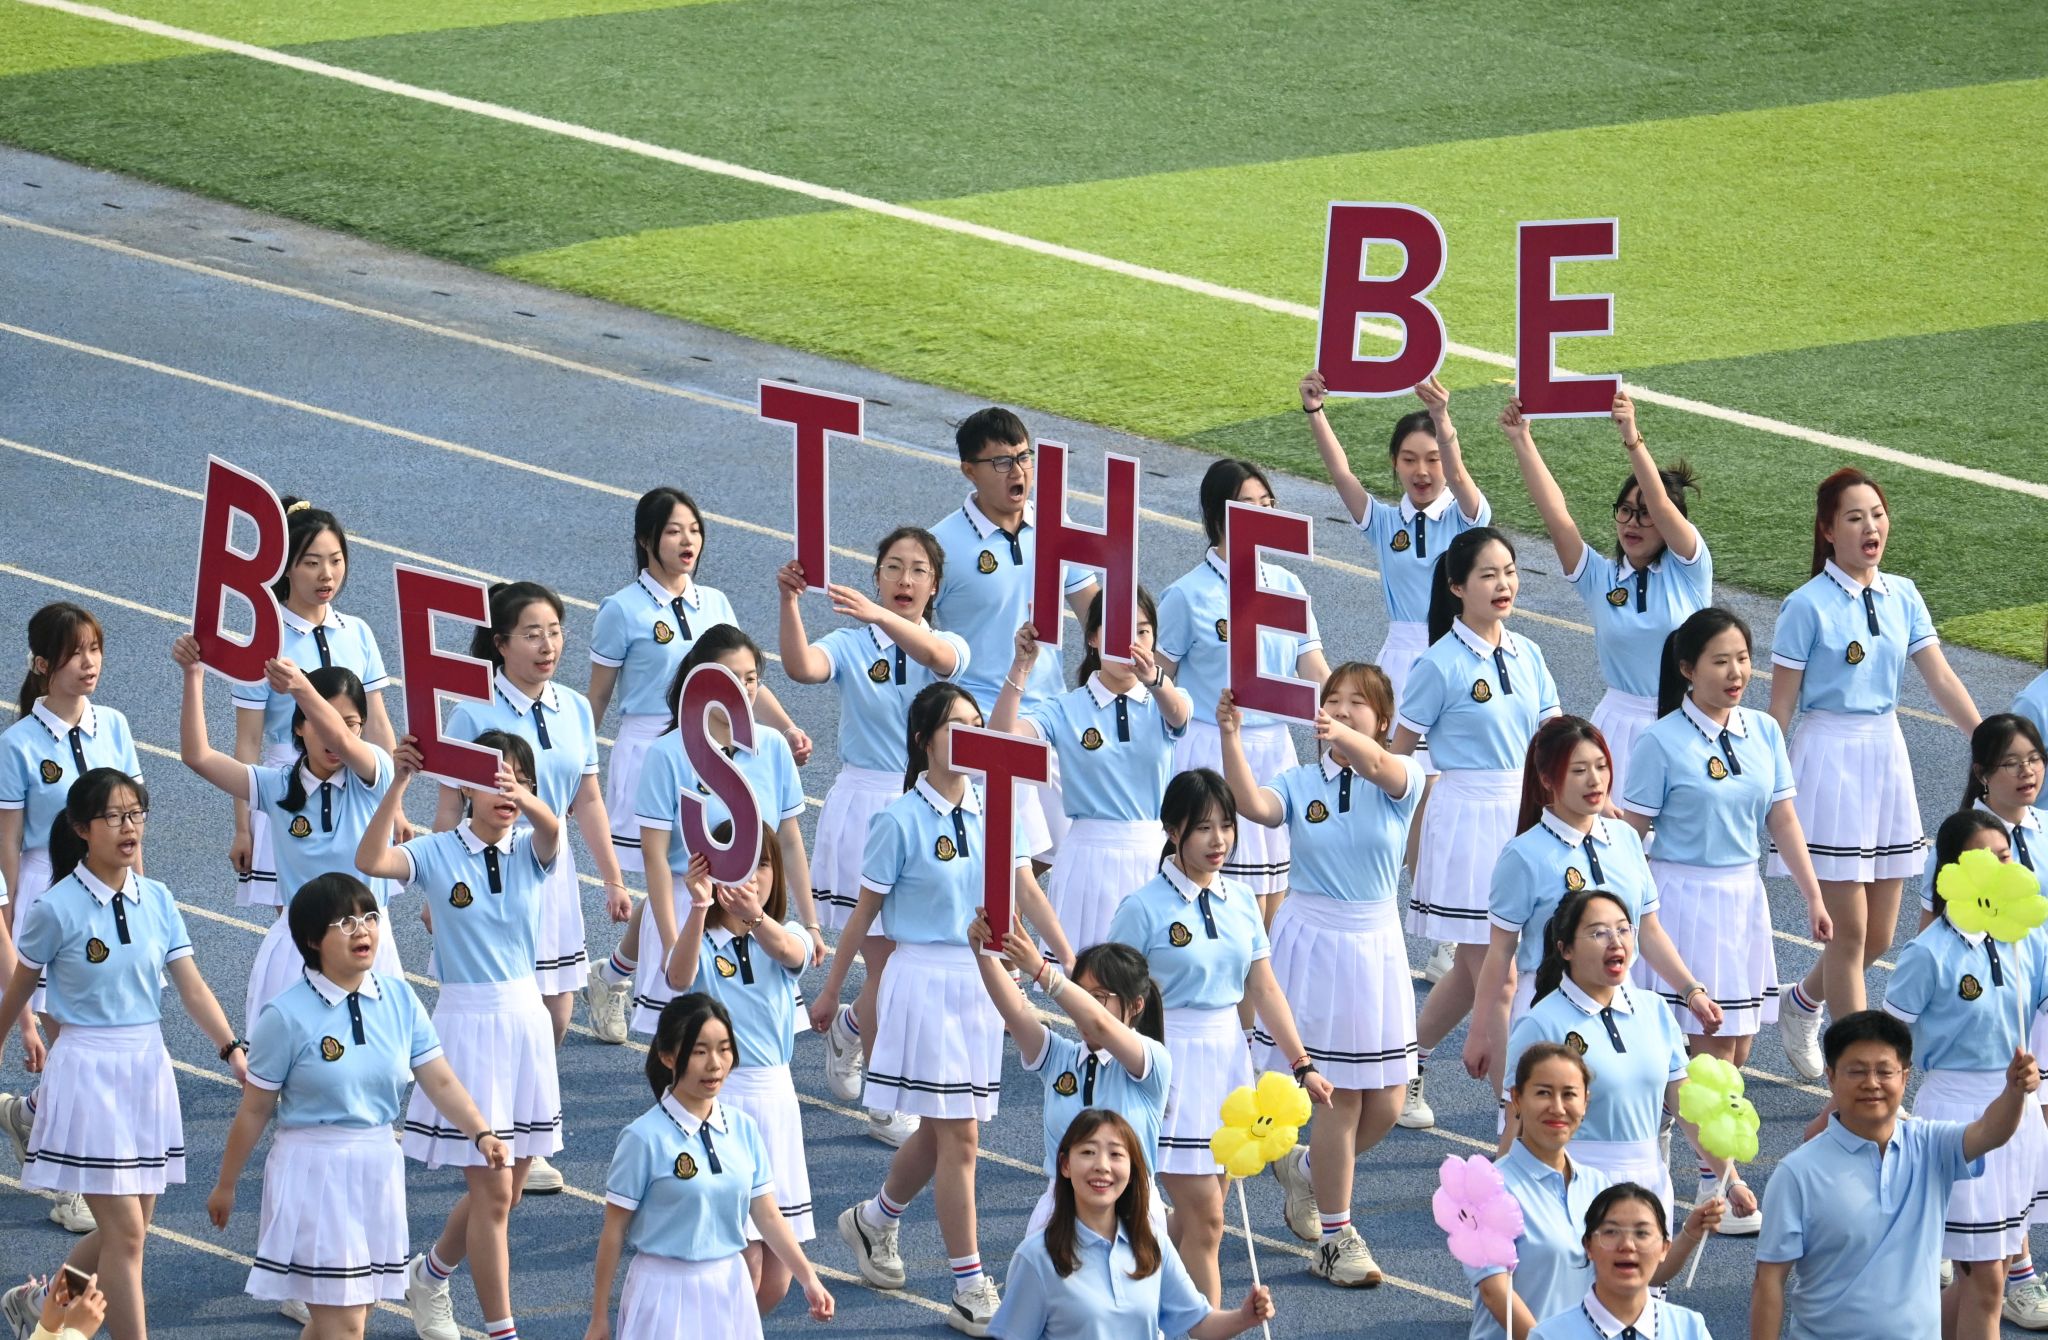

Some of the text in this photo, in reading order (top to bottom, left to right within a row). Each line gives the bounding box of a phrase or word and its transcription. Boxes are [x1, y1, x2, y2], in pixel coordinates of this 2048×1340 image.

[1316, 202, 1620, 418] BE
[192, 458, 1050, 955] BEST
[759, 382, 1316, 723] THE
